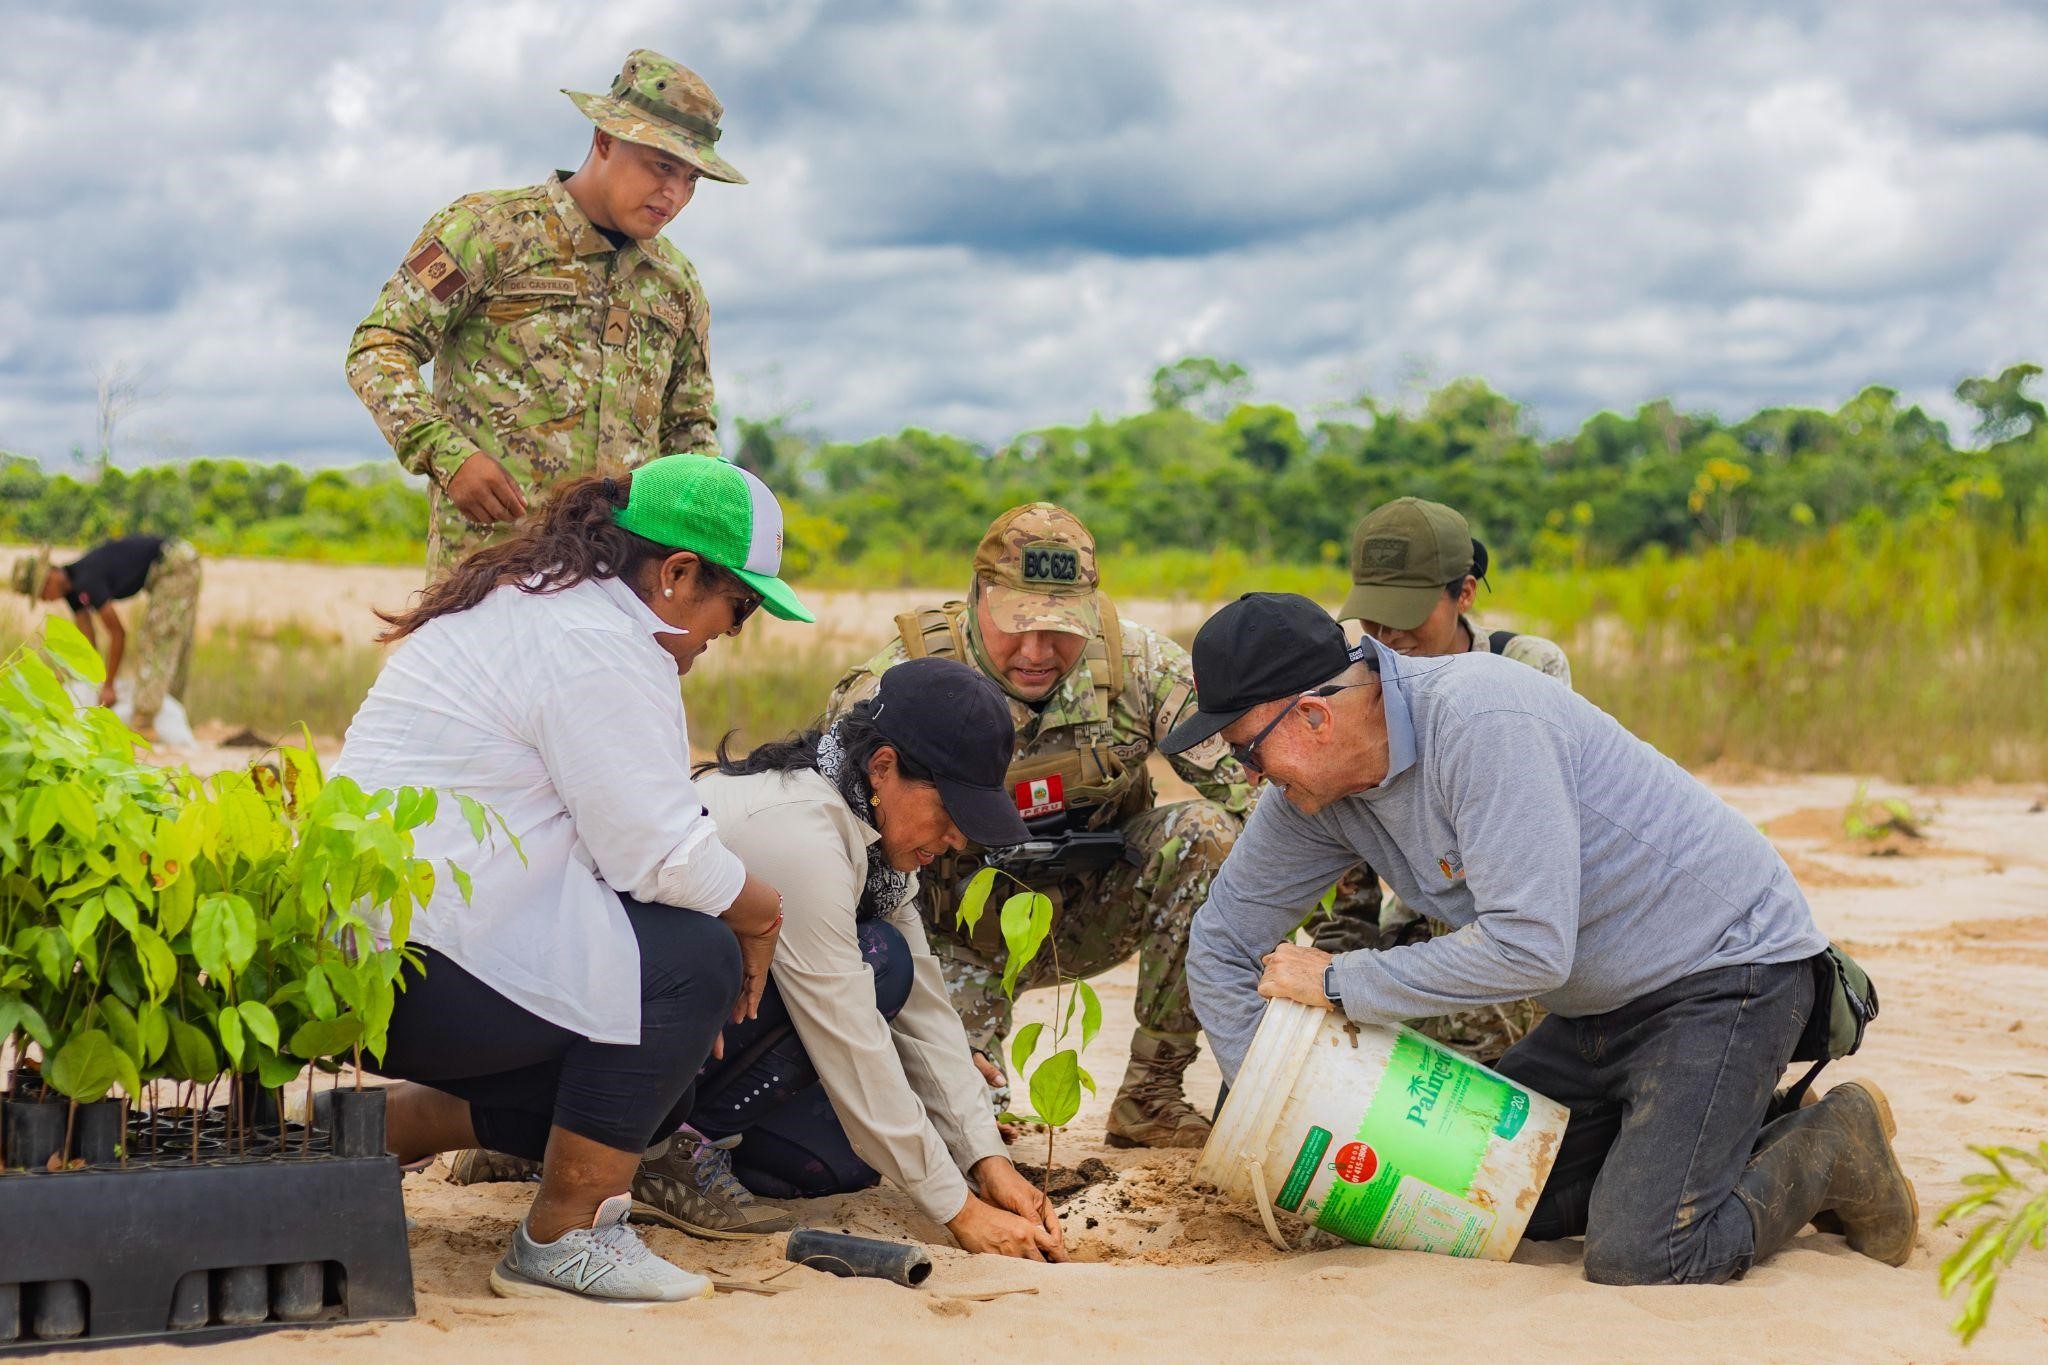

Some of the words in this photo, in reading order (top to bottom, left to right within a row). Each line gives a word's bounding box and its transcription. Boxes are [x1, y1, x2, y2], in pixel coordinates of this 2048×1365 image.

[510, 281, 526, 290] DEL
[1024, 803, 1059, 817] PERU
[1345, 1145, 1360, 1178] PEDIDOS
